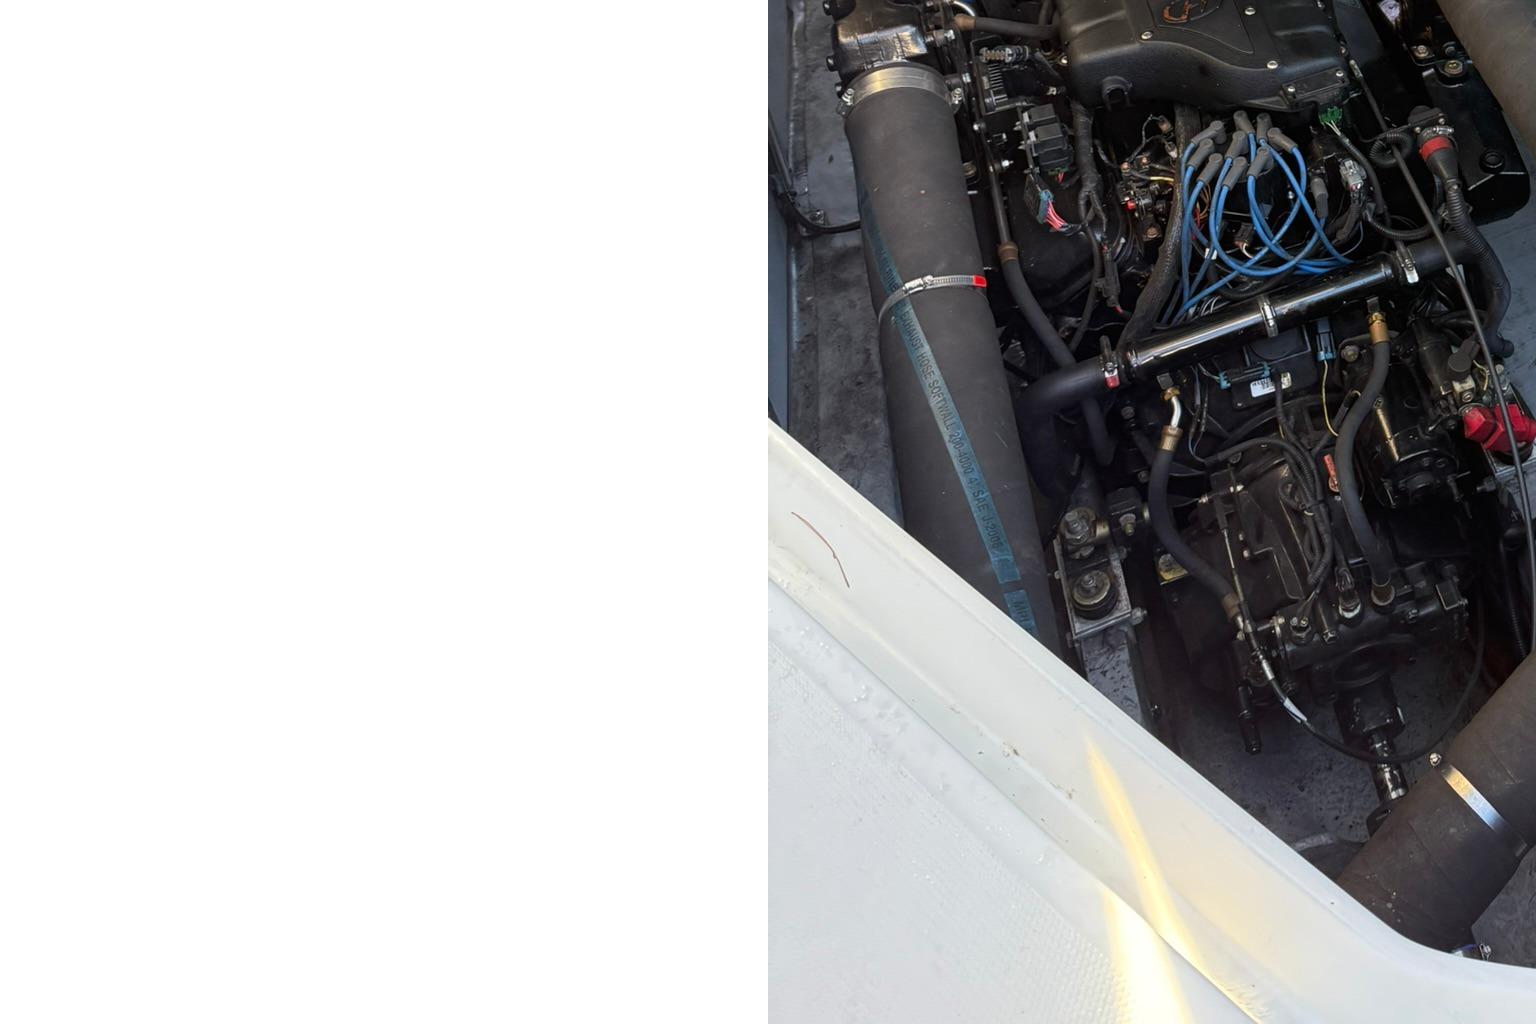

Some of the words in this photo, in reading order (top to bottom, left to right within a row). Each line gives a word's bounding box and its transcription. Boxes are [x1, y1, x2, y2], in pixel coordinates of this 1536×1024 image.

[900, 312, 923, 351] EXHAUST
[916, 351, 935, 379] HOSE
[928, 379, 956, 430] SOFTWALL
[949, 430, 974, 475] 200-4000
[972, 489, 989, 513] SAE
